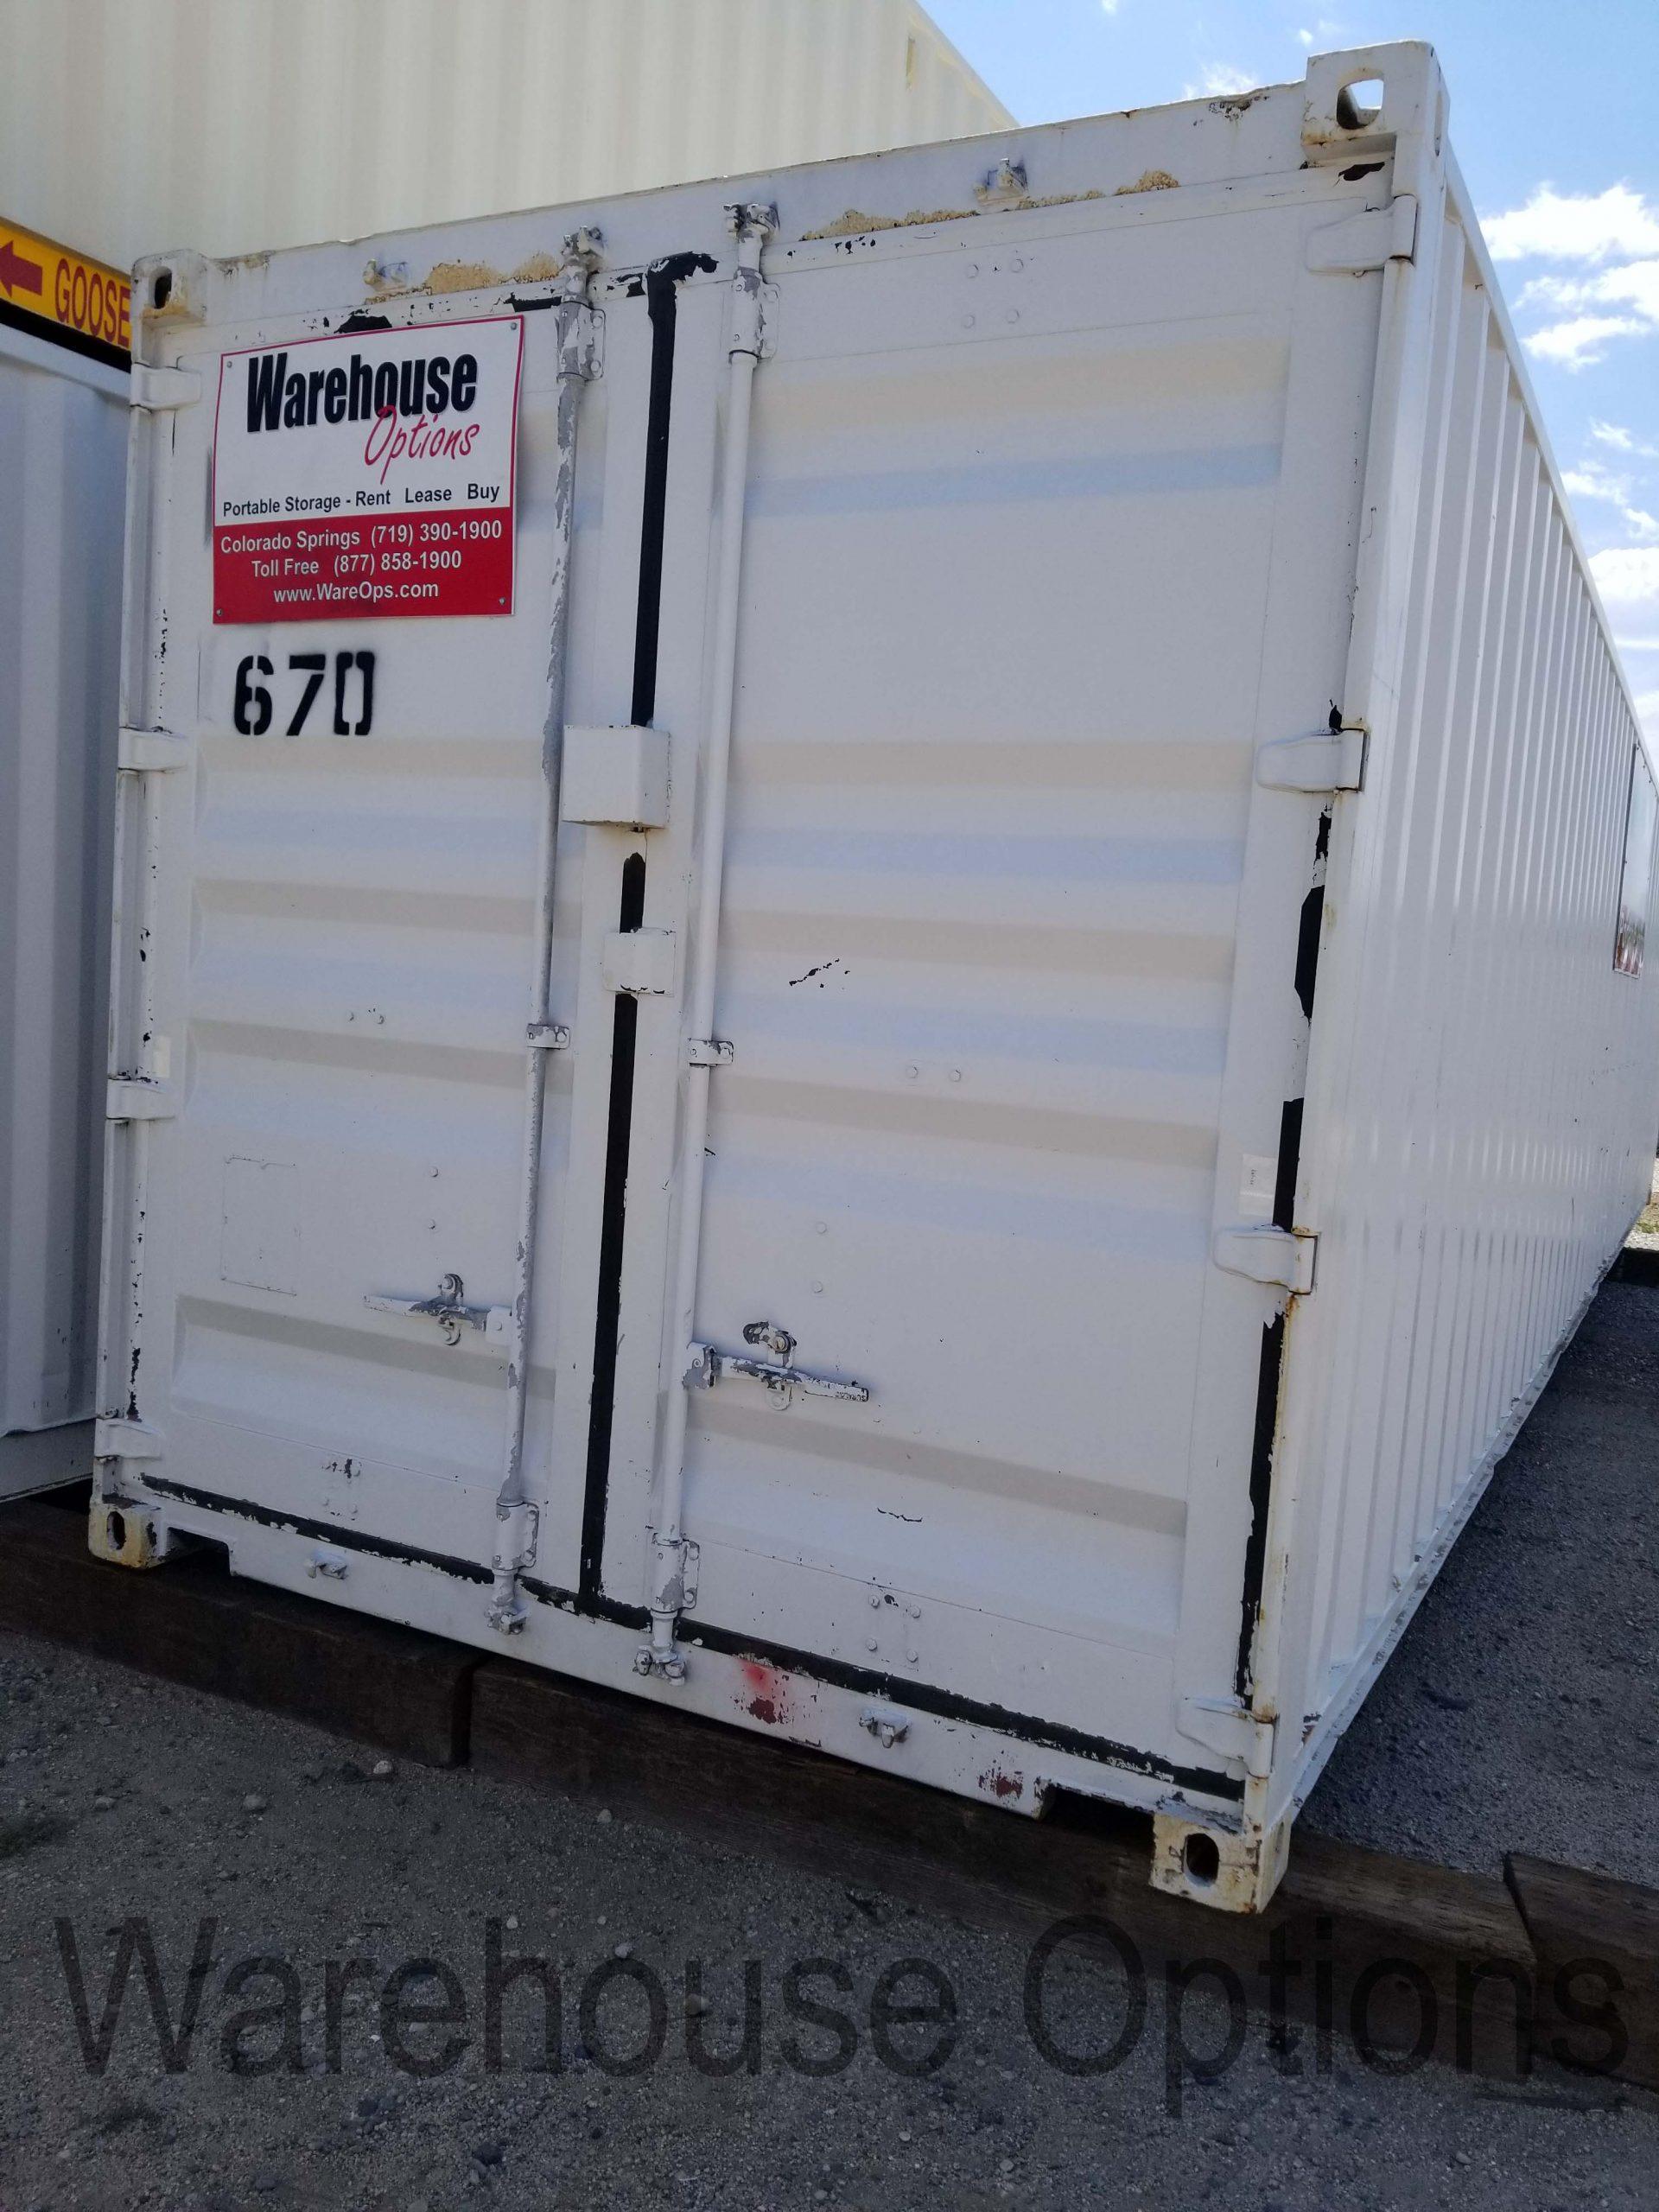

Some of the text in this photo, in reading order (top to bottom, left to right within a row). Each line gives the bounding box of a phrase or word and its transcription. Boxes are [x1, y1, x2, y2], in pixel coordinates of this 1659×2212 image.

[247, 352, 477, 432] Warehouse
[364, 404, 480, 485] Options
[223, 499, 280, 517] Portable
[285, 496, 340, 512] Storage
[355, 489, 391, 506] Rent
[404, 487, 452, 503] Lease
[467, 483, 499, 503] Buy
[220, 519, 502, 553] Colorado Springs (719) 390-1900
[251, 550, 461, 577] Toll Free (877) 858-1900
[273, 581, 439, 603] www.WareOps.com
[234, 652, 375, 736] 670
